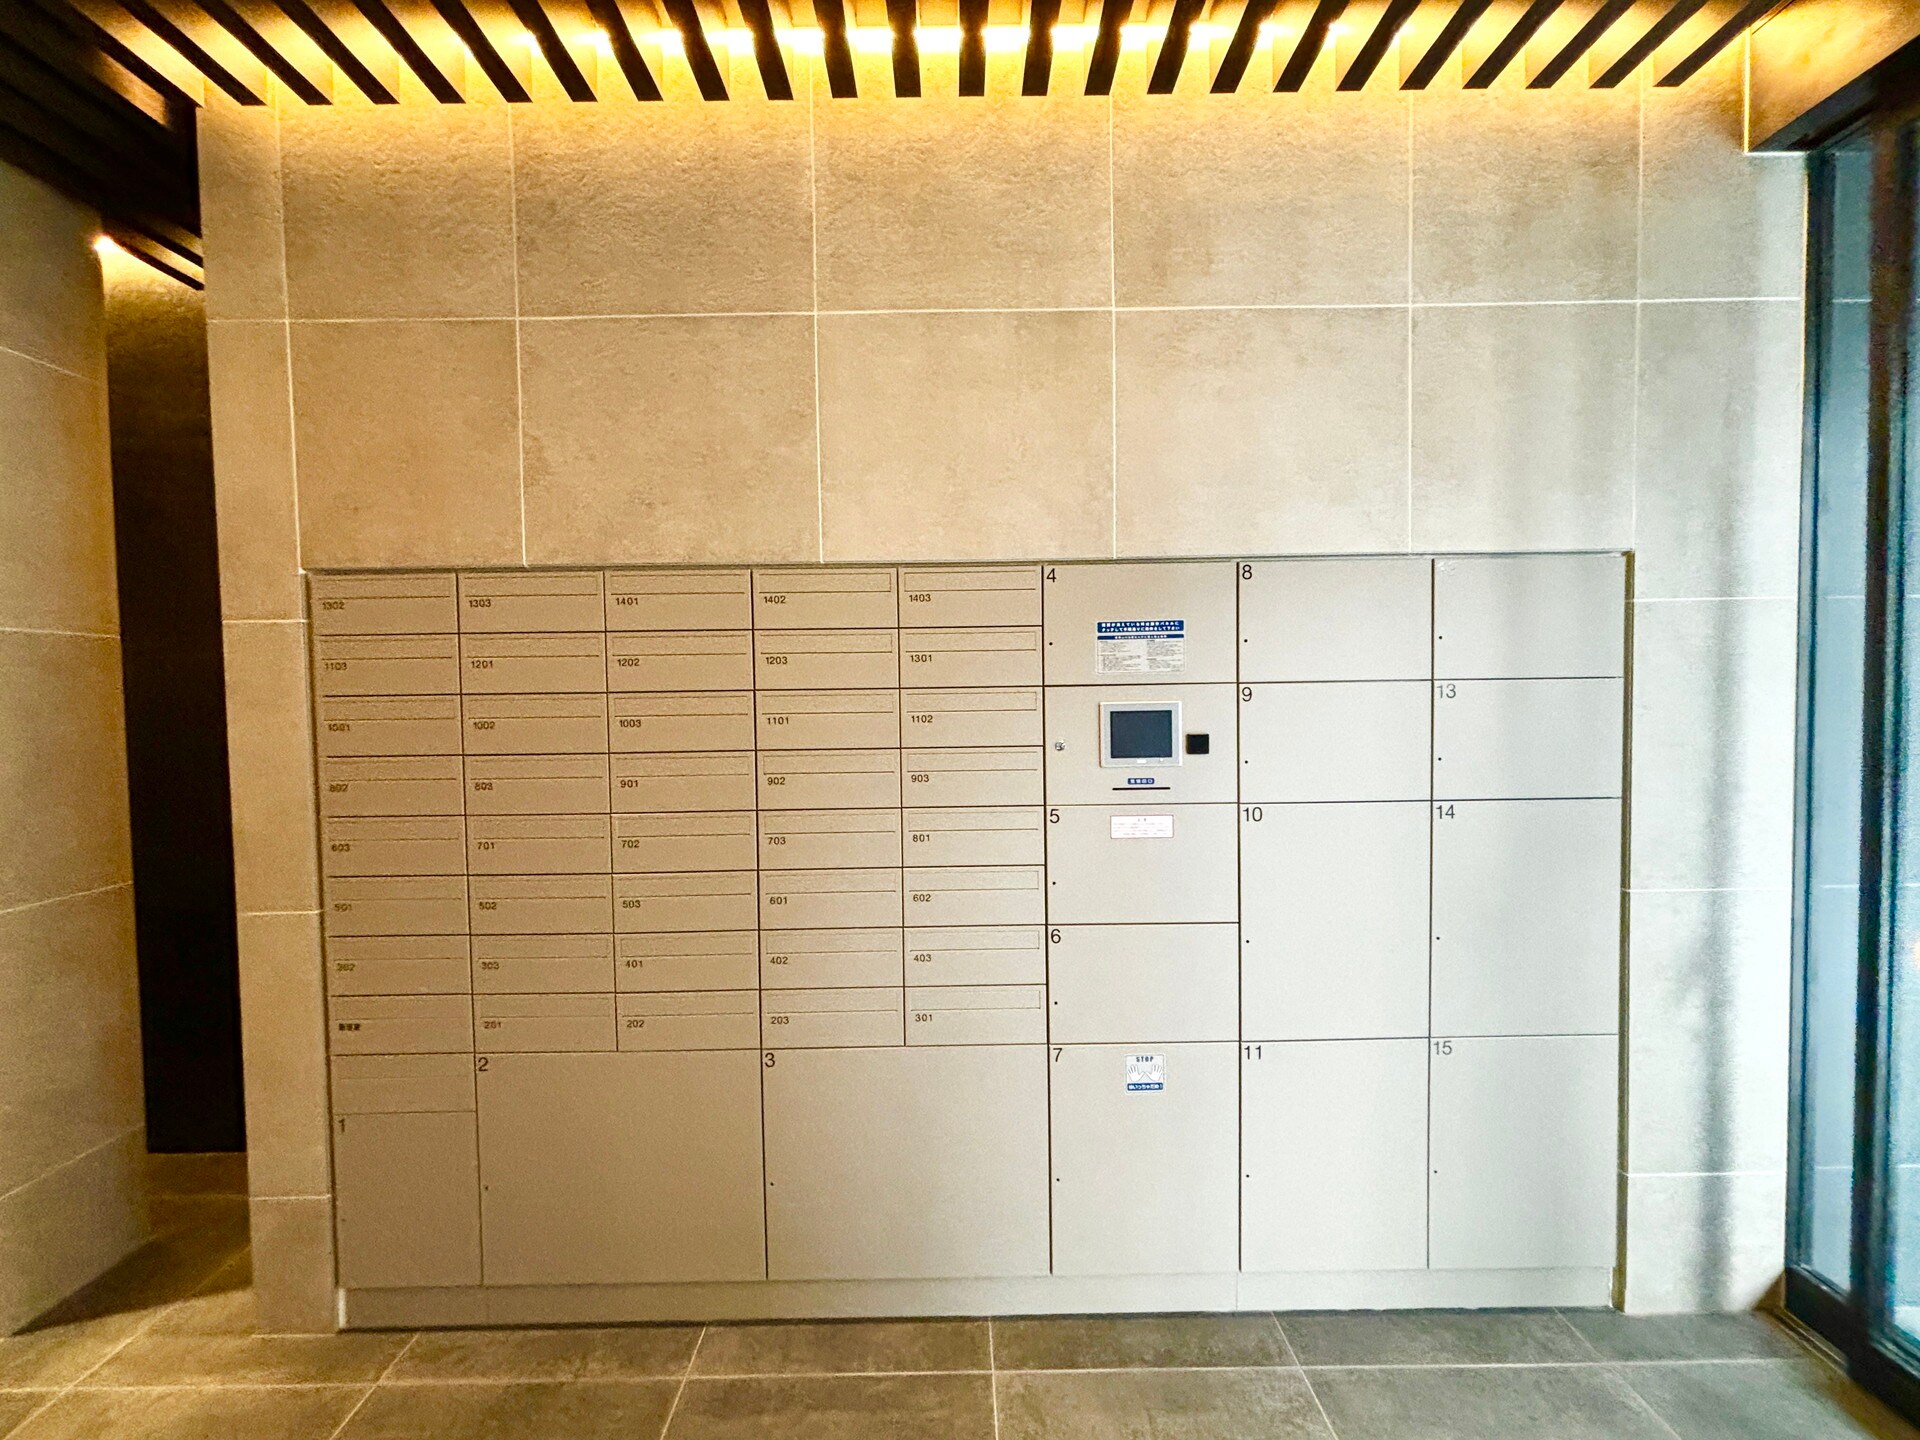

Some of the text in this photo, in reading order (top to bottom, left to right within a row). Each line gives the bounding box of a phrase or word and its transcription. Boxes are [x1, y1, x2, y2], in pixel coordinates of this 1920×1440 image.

[1046, 568, 1057, 583] 4
[1242, 564, 1252, 580] 8
[616, 597, 638, 606] 1401
[764, 595, 786, 604] 1402
[909, 594, 931, 602] 1403
[322, 601, 344, 610] 1302
[469, 599, 491, 608] 1303
[617, 658, 639, 667] 1202
[766, 656, 788, 665] 1203
[910, 654, 932, 662] 1301
[325, 662, 347, 670] 1103
[471, 660, 493, 669] 1201
[1242, 687, 1252, 702] 9
[1437, 684, 1456, 698] 13
[619, 719, 641, 728] 1003
[766, 716, 788, 725] 1101
[911, 715, 933, 723] 1102
[473, 721, 495, 730] 1002
[767, 777, 785, 786] 902
[911, 774, 929, 783] 903
[475, 782, 493, 791] 803
[620, 780, 638, 788] 901
[1243, 807, 1263, 822] 10
[1436, 804, 1455, 819] 14
[1050, 809, 1060, 824] 5
[768, 837, 786, 845] 703
[913, 834, 929, 842] 801
[331, 844, 350, 852] 603
[478, 842, 494, 850] 701
[621, 840, 640, 848] 702
[770, 896, 787, 905] 601
[913, 894, 931, 902] 602
[479, 902, 497, 910] 502
[623, 900, 641, 908] 503
[1051, 929, 1061, 944] 6
[770, 956, 788, 964] 402
[914, 954, 931, 962] 403
[482, 962, 499, 970] 303
[625, 960, 642, 968] 401
[771, 1016, 789, 1024] 203
[915, 1013, 932, 1022] 301
[627, 1020, 644, 1028] 202
[1434, 1040, 1452, 1055] 15
[1053, 1048, 1063, 1062] 7
[1244, 1045, 1261, 1060] 11
[478, 1057, 488, 1072] 2
[765, 1052, 775, 1068] 3
[338, 1119, 345, 1133] 1
